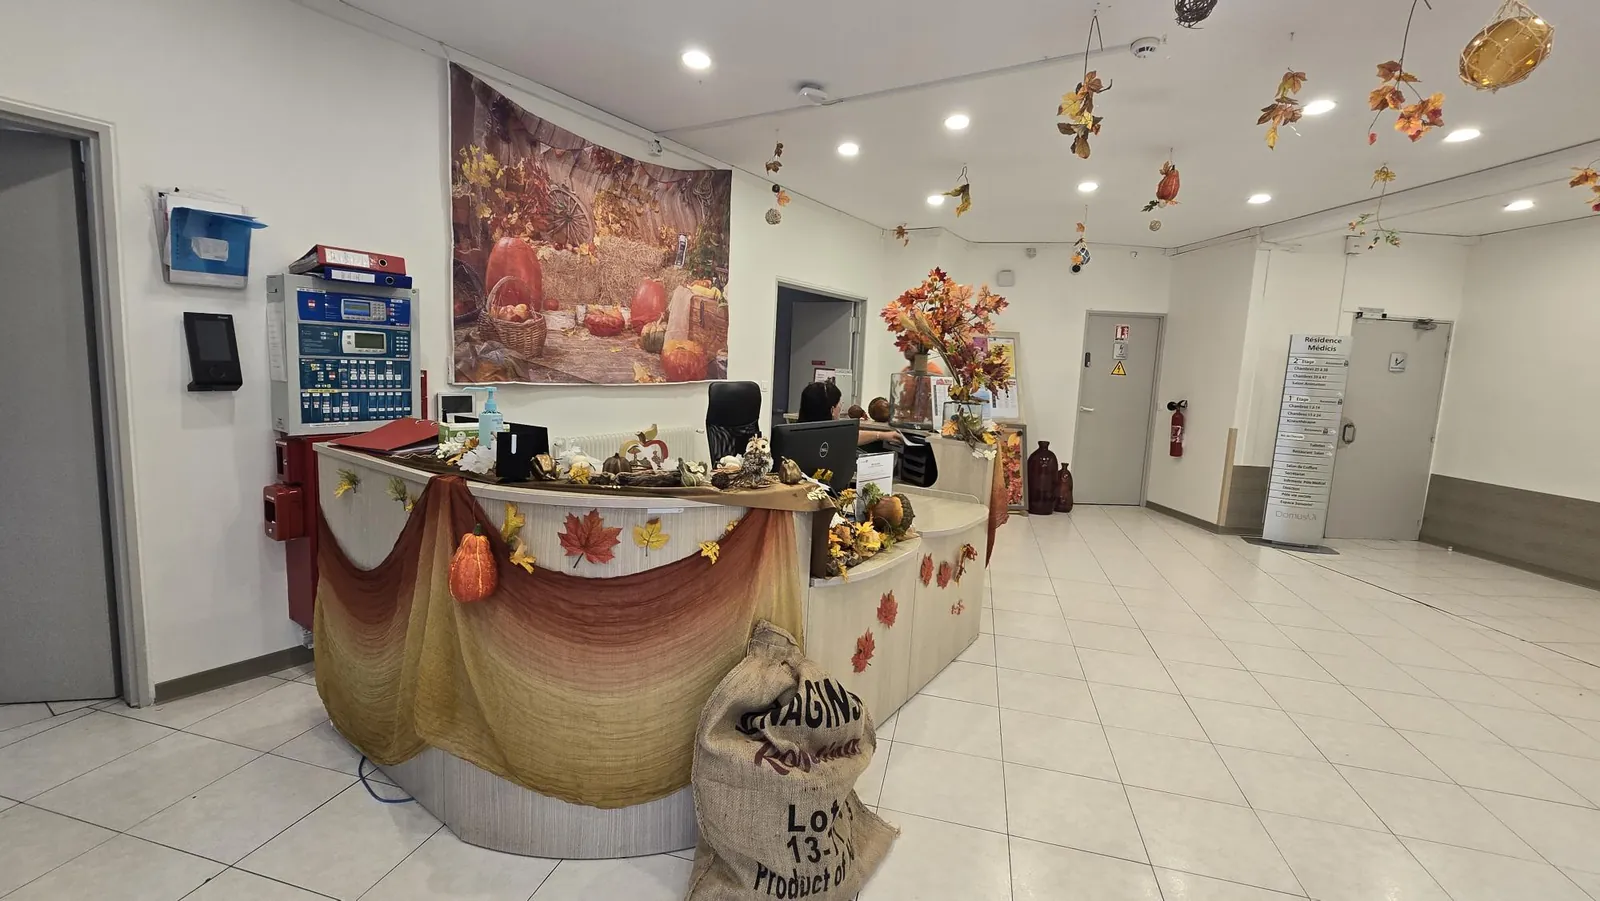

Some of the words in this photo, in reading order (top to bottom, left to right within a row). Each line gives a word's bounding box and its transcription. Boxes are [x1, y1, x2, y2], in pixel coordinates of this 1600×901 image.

[1304, 336, 1342, 344] Résidence
[1307, 344, 1337, 352] Médicis
[754, 861, 831, 900] Product
